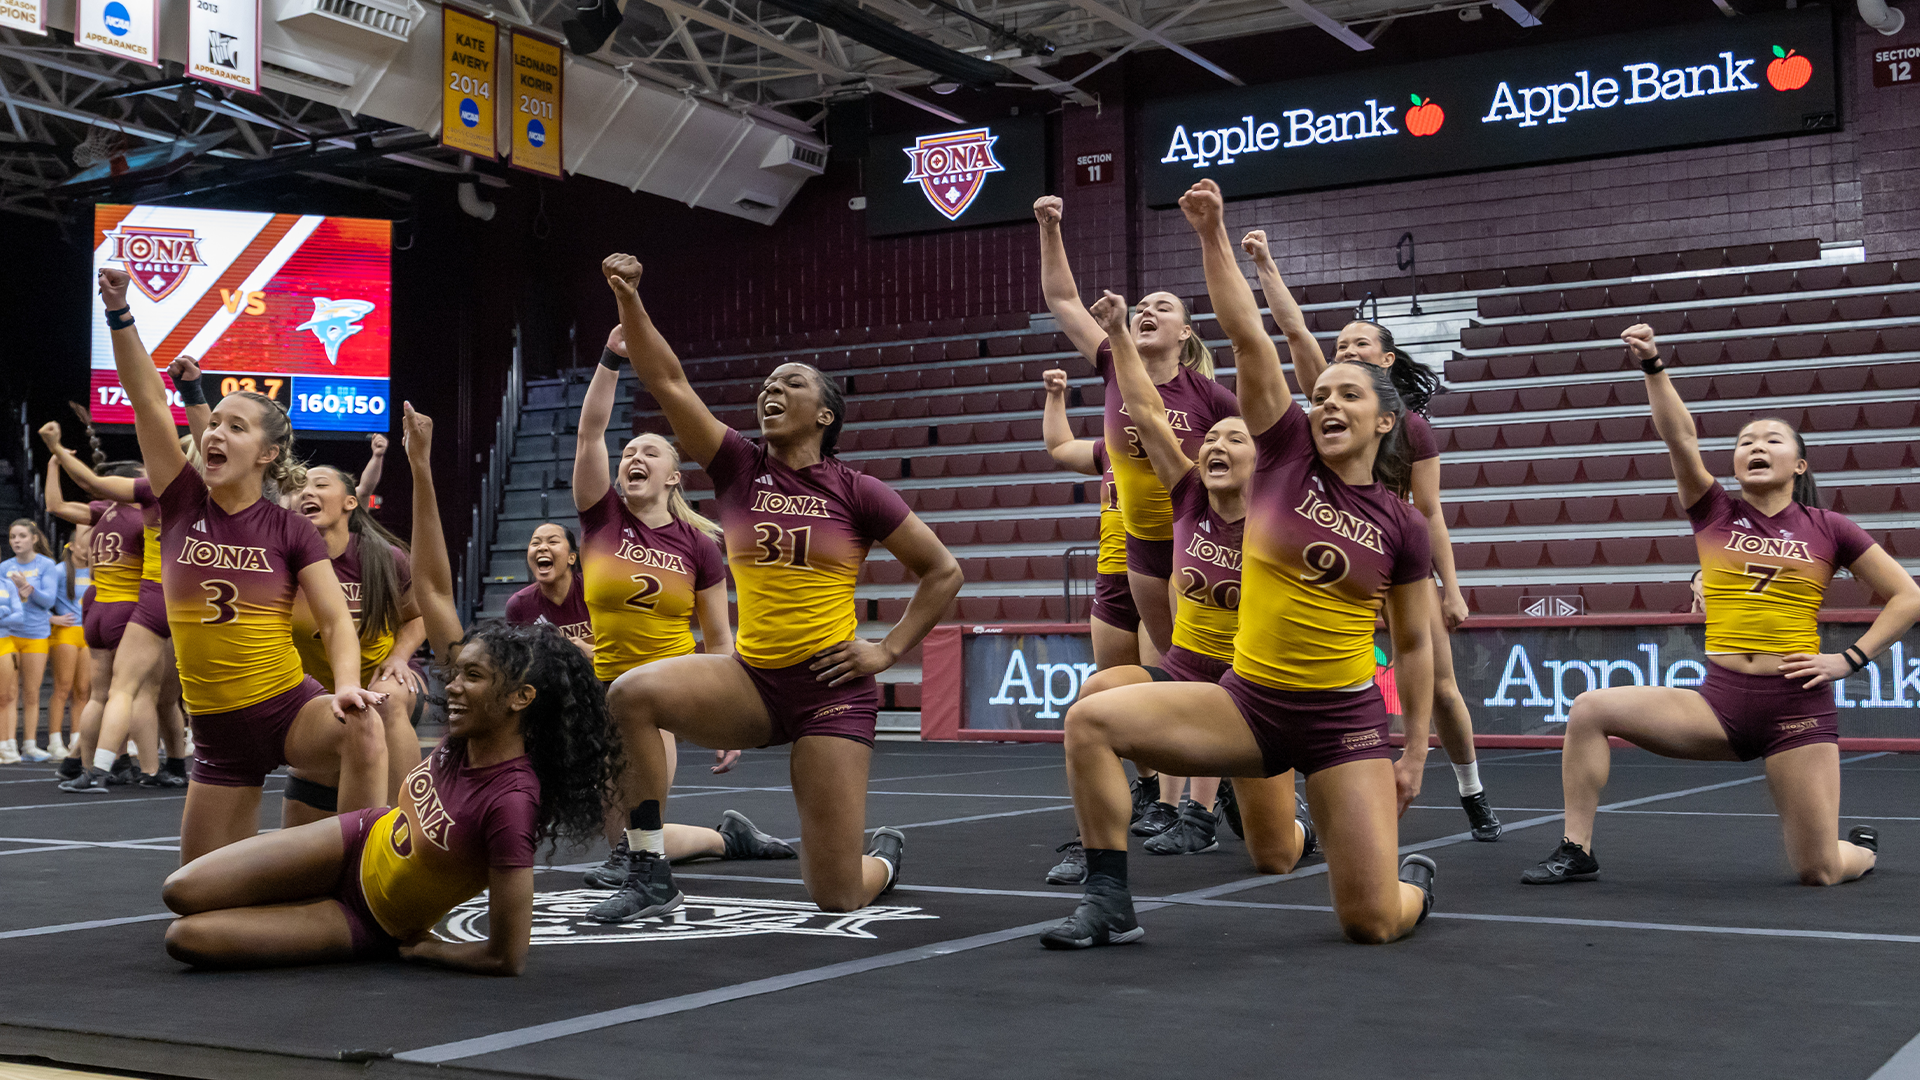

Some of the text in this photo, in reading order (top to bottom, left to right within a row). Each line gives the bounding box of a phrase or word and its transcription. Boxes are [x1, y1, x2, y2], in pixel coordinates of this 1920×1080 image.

[197, 0, 218, 14] 2013
[85, 32, 148, 55] APPEARANCES
[456, 32, 486, 53] KATE
[194, 63, 251, 85] APPEARANCES
[451, 51, 490, 72] AVERY
[515, 53, 558, 77] LEONARD
[1888, 61, 1912, 82] 12
[450, 72, 490, 100] 2014
[520, 73, 553, 94] KORIR
[1481, 51, 1760, 128] Apple Bank
[520, 95, 553, 120] 2011
[1160, 99, 1399, 168] Apple Bank
[911, 139, 994, 178] IONA
[1076, 153, 1112, 166] SECTION
[932, 172, 974, 186] GAELS
[1087, 165, 1101, 182] 11
[111, 236, 202, 264] IONA
[133, 262, 180, 274] GAELS
[220, 288, 267, 316] VS
[297, 393, 386, 416] 160.150
[751, 490, 831, 518] IONA
[1294, 489, 1385, 555] IONA
[177, 536, 274, 573] IONA
[614, 538, 688, 576] IONA
[753, 522, 814, 571] 31
[1723, 528, 1815, 564] IONA
[1300, 541, 1351, 589] 9
[1743, 561, 1784, 596] 7
[200, 578, 239, 627] 3
[623, 572, 663, 612] 2
[1180, 566, 1242, 612] 20
[405, 755, 456, 851] IONA
